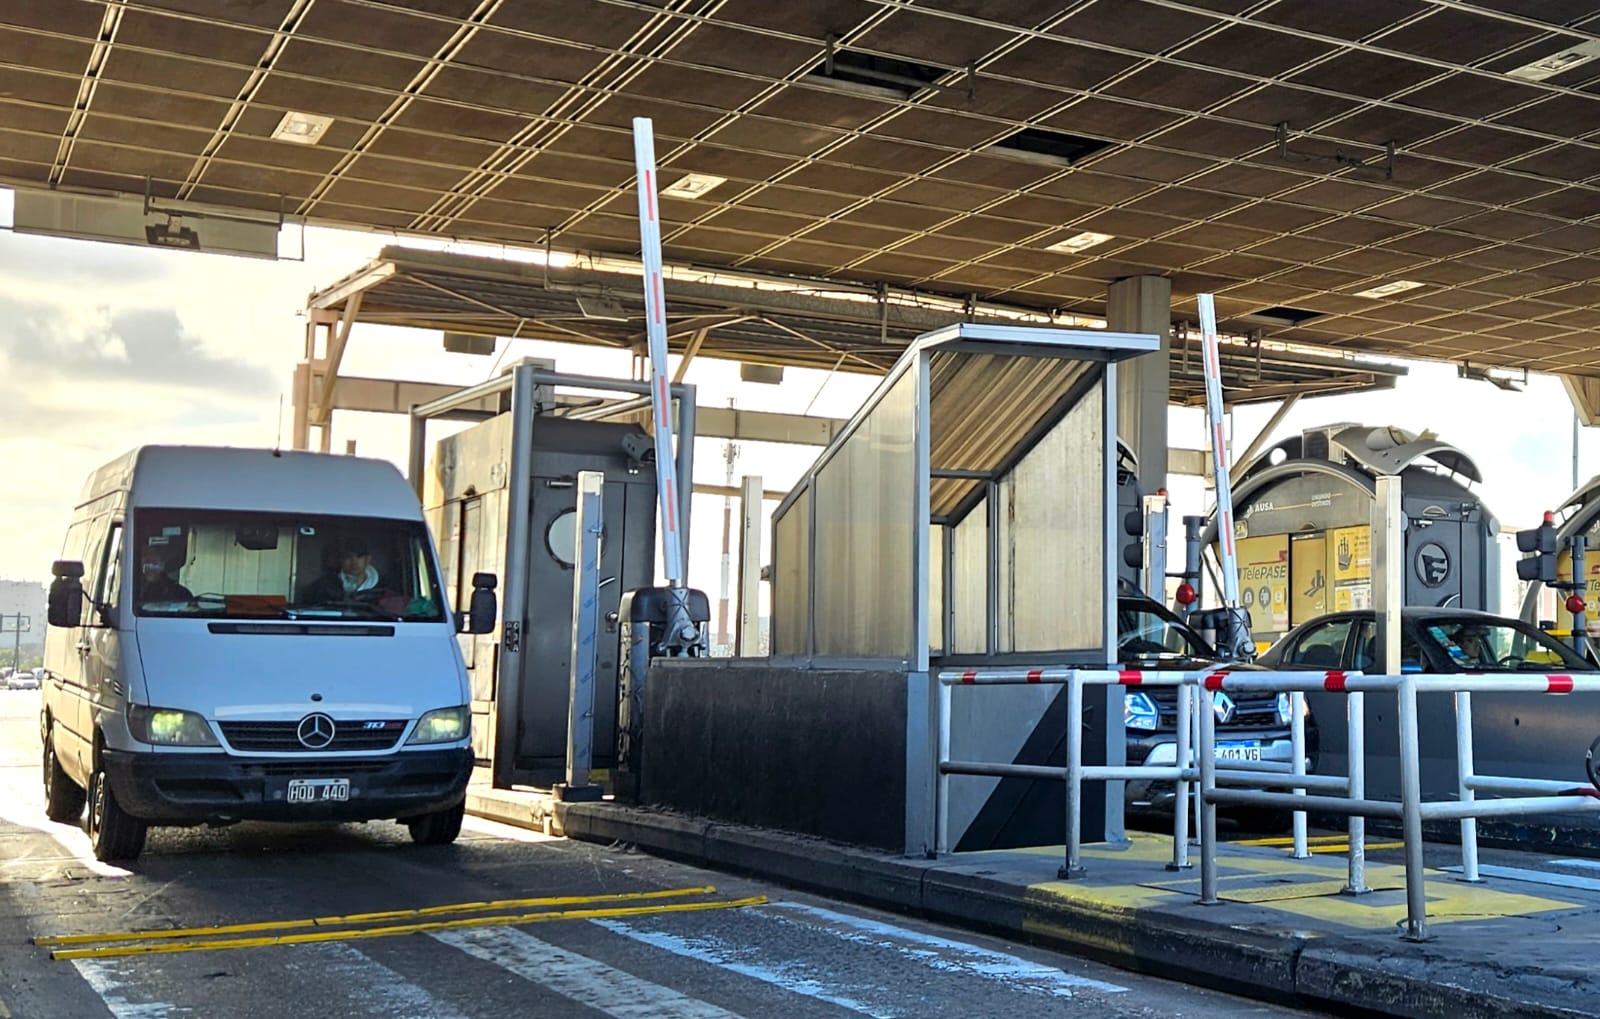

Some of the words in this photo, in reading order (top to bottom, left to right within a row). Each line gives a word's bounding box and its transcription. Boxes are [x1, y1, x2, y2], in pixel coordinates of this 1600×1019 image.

[1255, 502, 1274, 513] AUSA
[1242, 565, 1287, 580] TelePASE
[322, 784, 347, 800] 440
